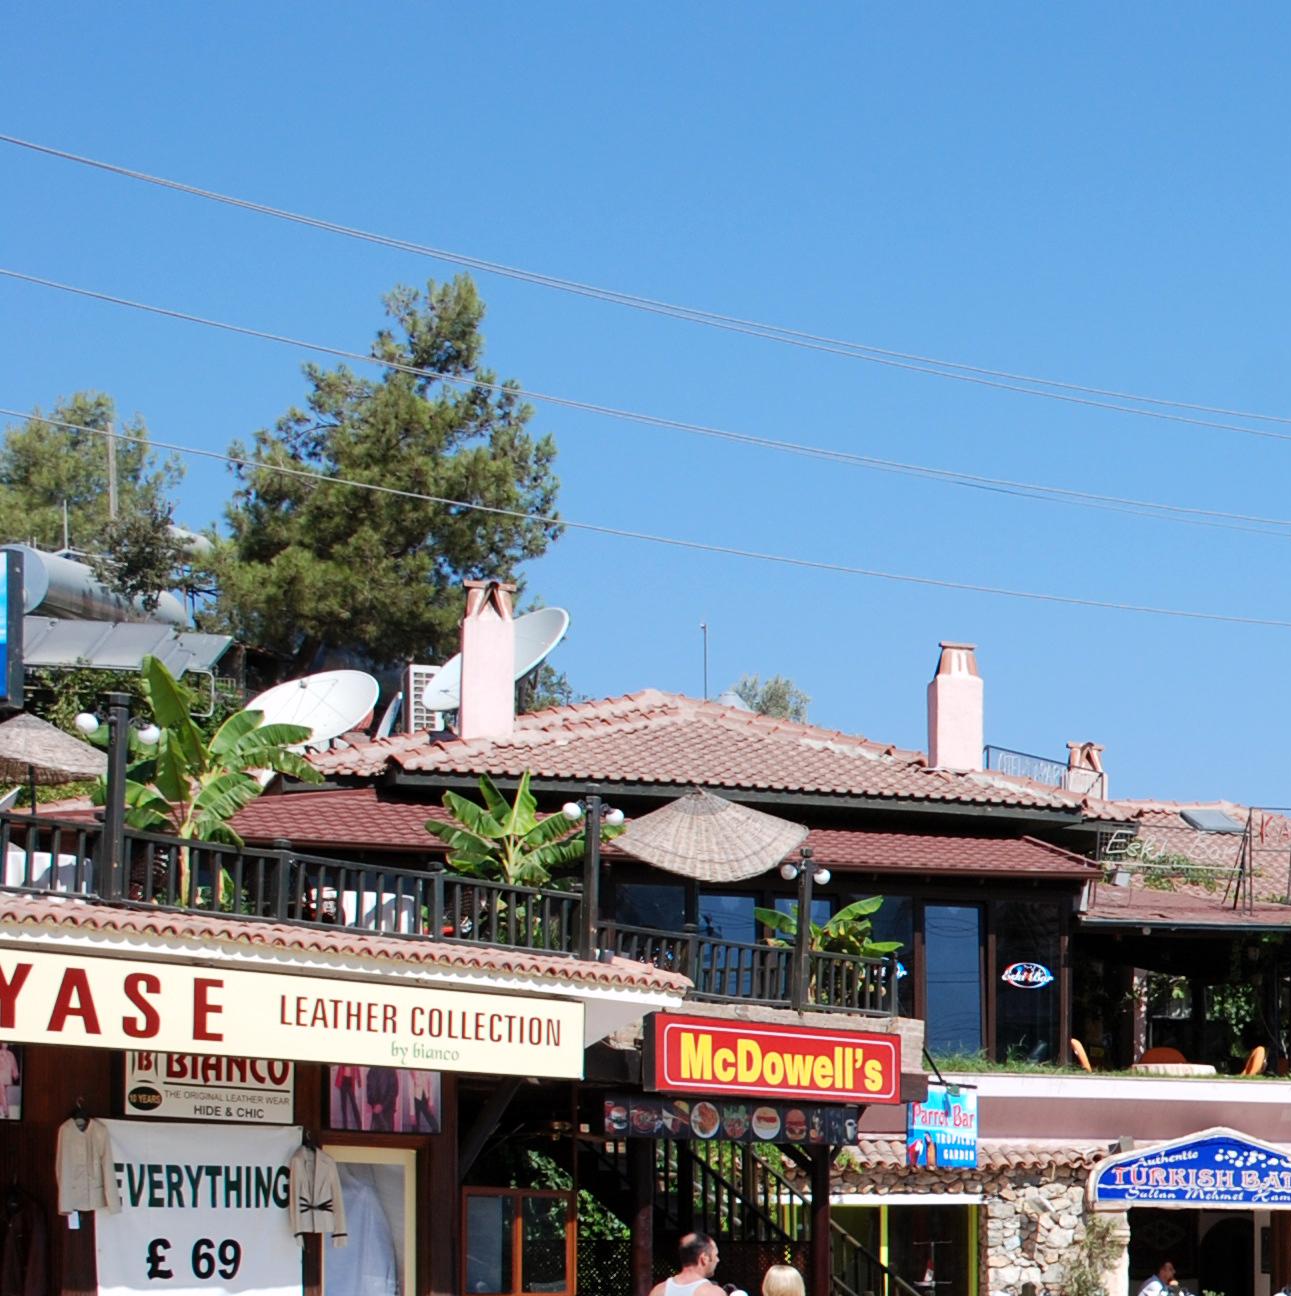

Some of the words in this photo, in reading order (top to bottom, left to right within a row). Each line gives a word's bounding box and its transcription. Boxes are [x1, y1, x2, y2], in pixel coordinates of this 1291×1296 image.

[0, 963, 223, 1041] YASE
[280, 995, 398, 1034] LEATHER
[410, 1006, 561, 1047] COLLECTION
[391, 1041, 408, 1065] by
[413, 1043, 460, 1062] bianco
[680, 1032, 883, 1092] McDowell's
[164, 1089, 181, 1099] THE
[183, 1091, 223, 1102] ORIGINAL
[225, 1093, 264, 1105] LEATHER
[265, 1096, 290, 1106] WEAR
[193, 1105, 222, 1117] HIDE
[225, 1107, 233, 1117] &
[236, 1107, 265, 1119] CHIC
[952, 1105, 976, 1129] Bar
[1133, 1150, 1199, 1168] Authentic
[1113, 1166, 1234, 1188] TURKISH
[146, 1238, 174, 1280] £
[191, 1238, 242, 1280] 69
